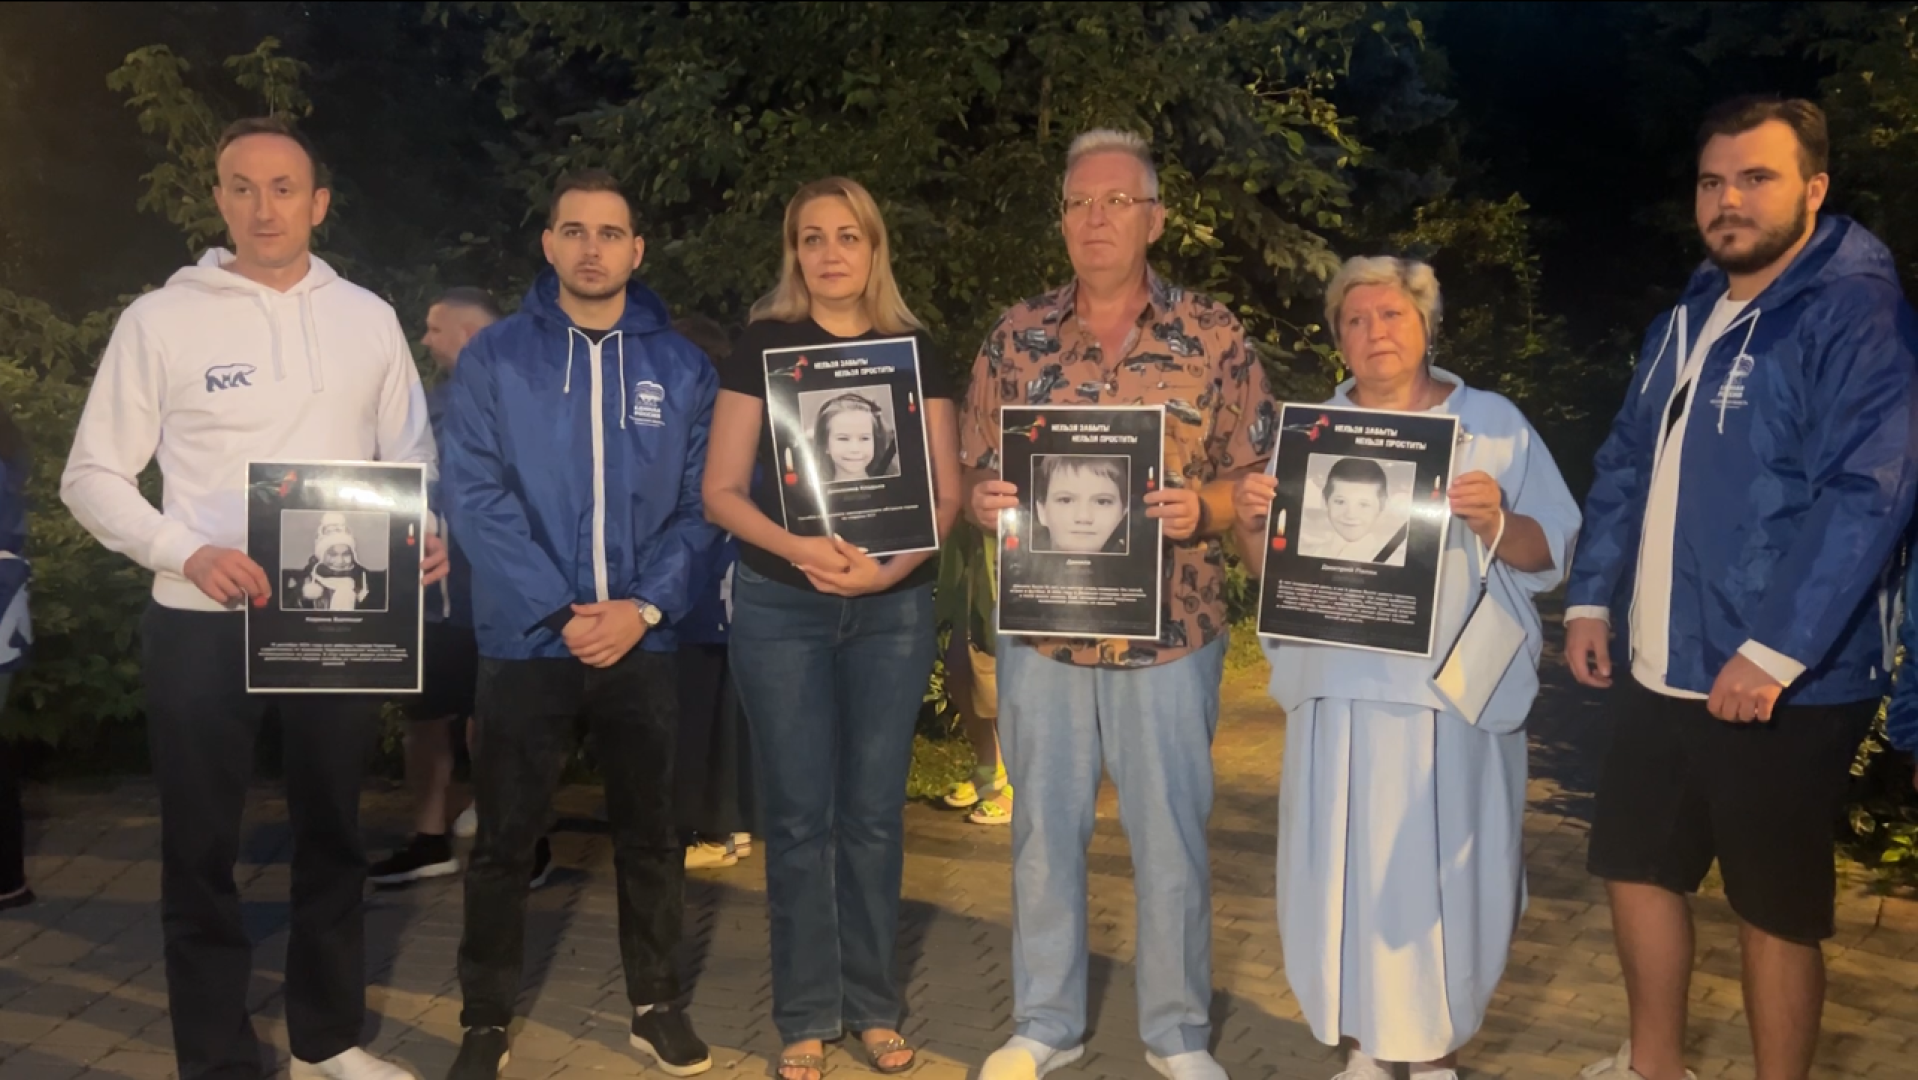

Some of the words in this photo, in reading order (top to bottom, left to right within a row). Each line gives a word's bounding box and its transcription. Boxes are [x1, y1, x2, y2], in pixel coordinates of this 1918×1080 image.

[1051, 423, 1078, 433] НЕЛЬЗЯ
[1334, 423, 1363, 434] НЕЛЬЗЯ
[1071, 434, 1099, 443] НЕЛЬЗЯ
[1355, 436, 1384, 447] НЕЛЬЗЯ
